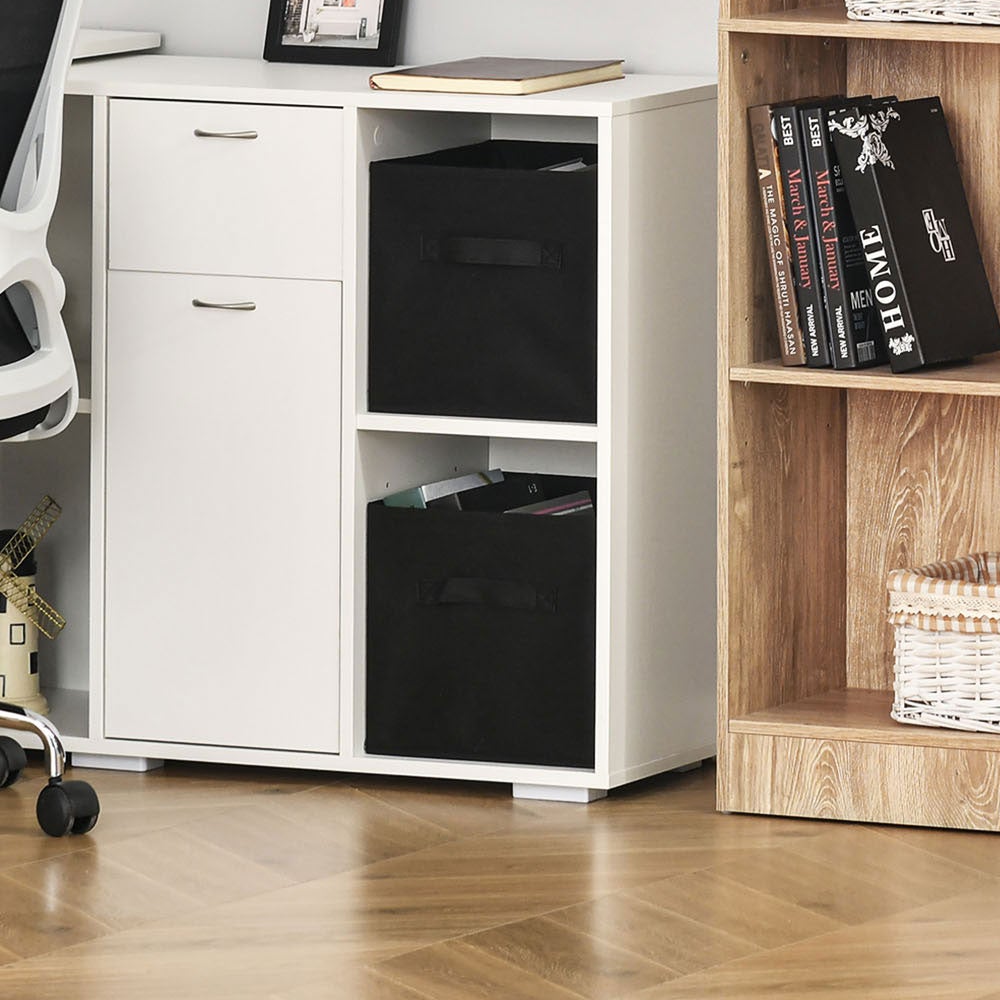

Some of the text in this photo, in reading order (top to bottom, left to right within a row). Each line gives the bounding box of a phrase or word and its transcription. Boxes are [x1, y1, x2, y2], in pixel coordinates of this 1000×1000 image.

[781, 115, 794, 146] BEST
[808, 116, 822, 147] BEST
[766, 184, 775, 204] THE
[769, 208, 781, 246] MAGIC
[787, 169, 812, 289] March & January
[816, 169, 841, 291] March & January
[775, 250, 784, 266] OF
[859, 224, 905, 333] HOME
[778, 271, 790, 307] SHRUTI
[784, 311, 796, 355] HAASAN
[806, 304, 819, 357] NEW ARRIVAL
[835, 305, 848, 358] NEW ARRIVAL
